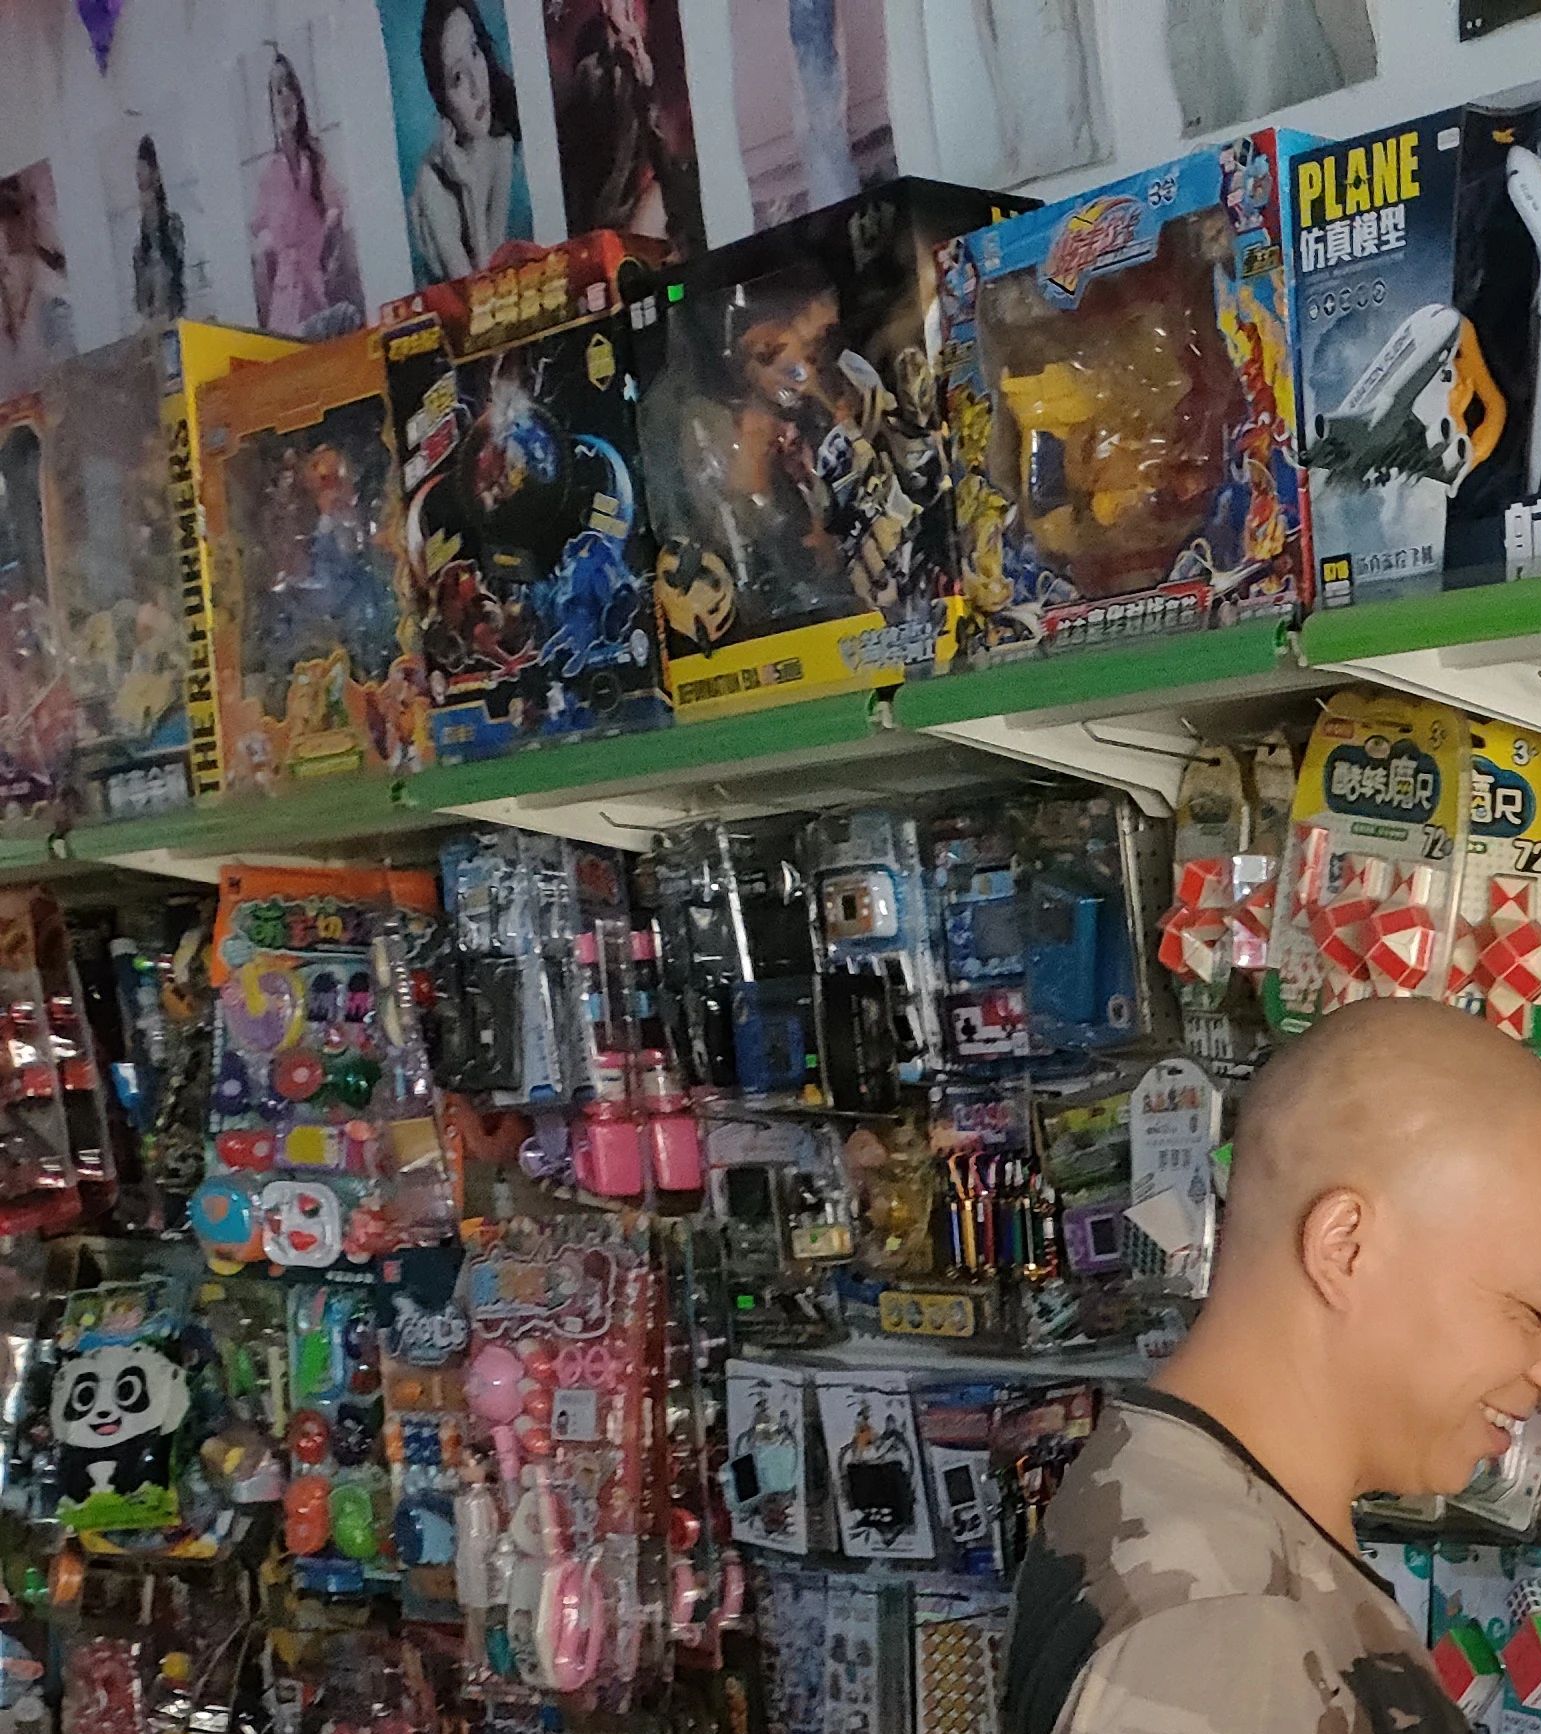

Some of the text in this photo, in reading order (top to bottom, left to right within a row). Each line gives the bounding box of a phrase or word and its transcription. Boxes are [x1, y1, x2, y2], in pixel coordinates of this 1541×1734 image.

[1298, 131, 1421, 228] PLANE
[1300, 203, 1407, 274] 仿真模型
